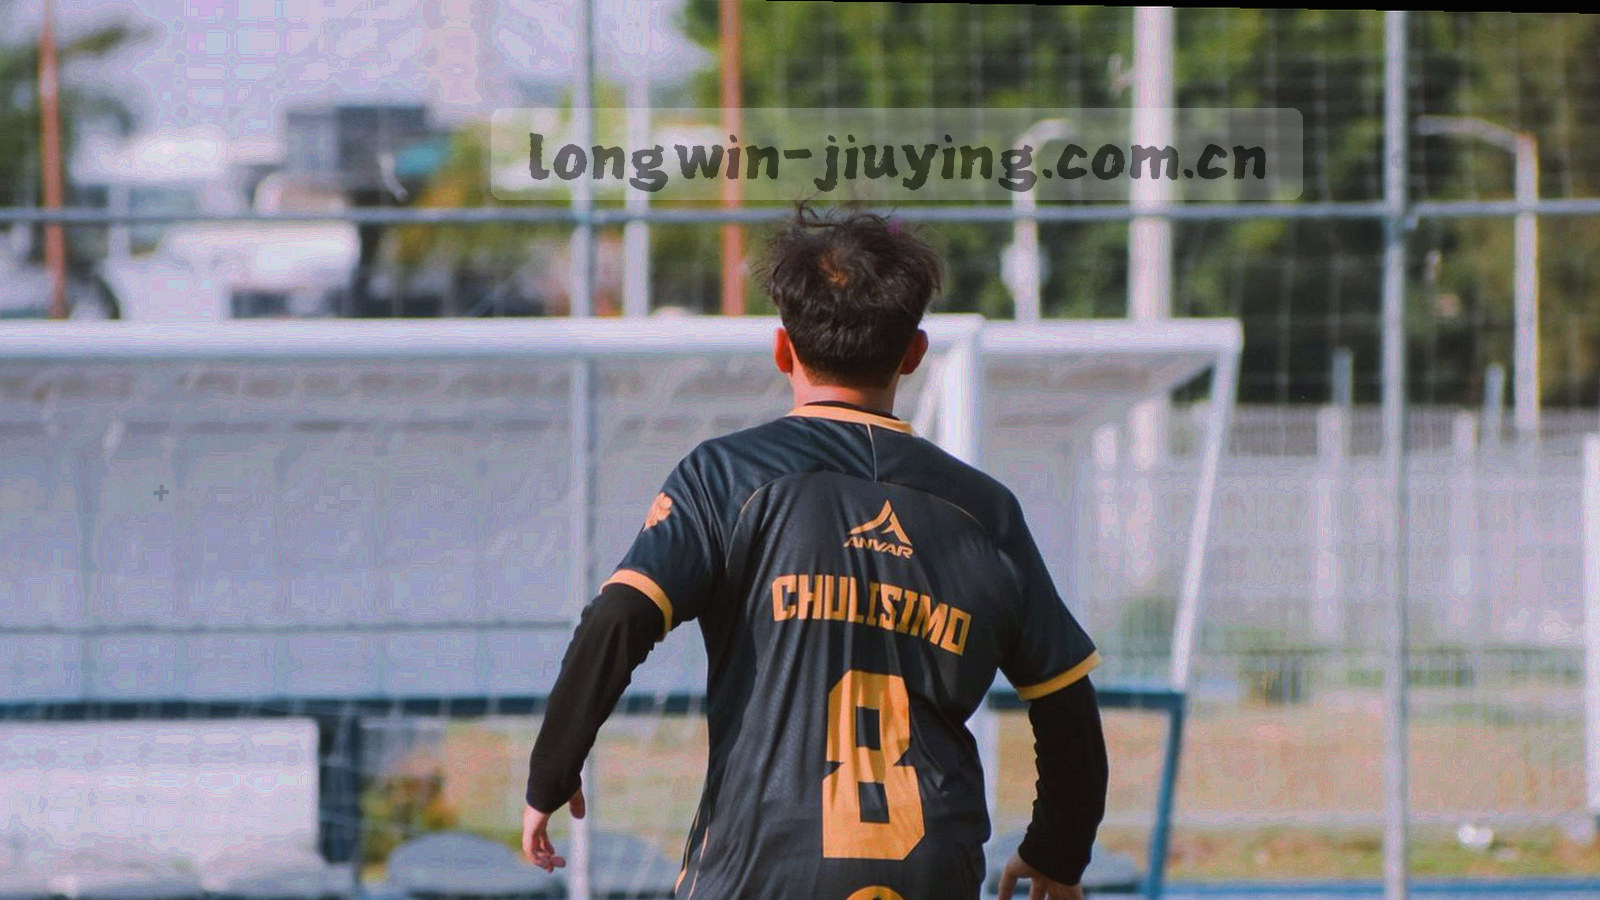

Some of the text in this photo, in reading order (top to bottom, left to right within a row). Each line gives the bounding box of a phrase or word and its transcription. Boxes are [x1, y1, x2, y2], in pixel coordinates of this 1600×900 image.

[844, 536, 914, 559] ANVAR
[772, 574, 972, 656] CHULISIMO
[822, 669, 926, 861] 8
